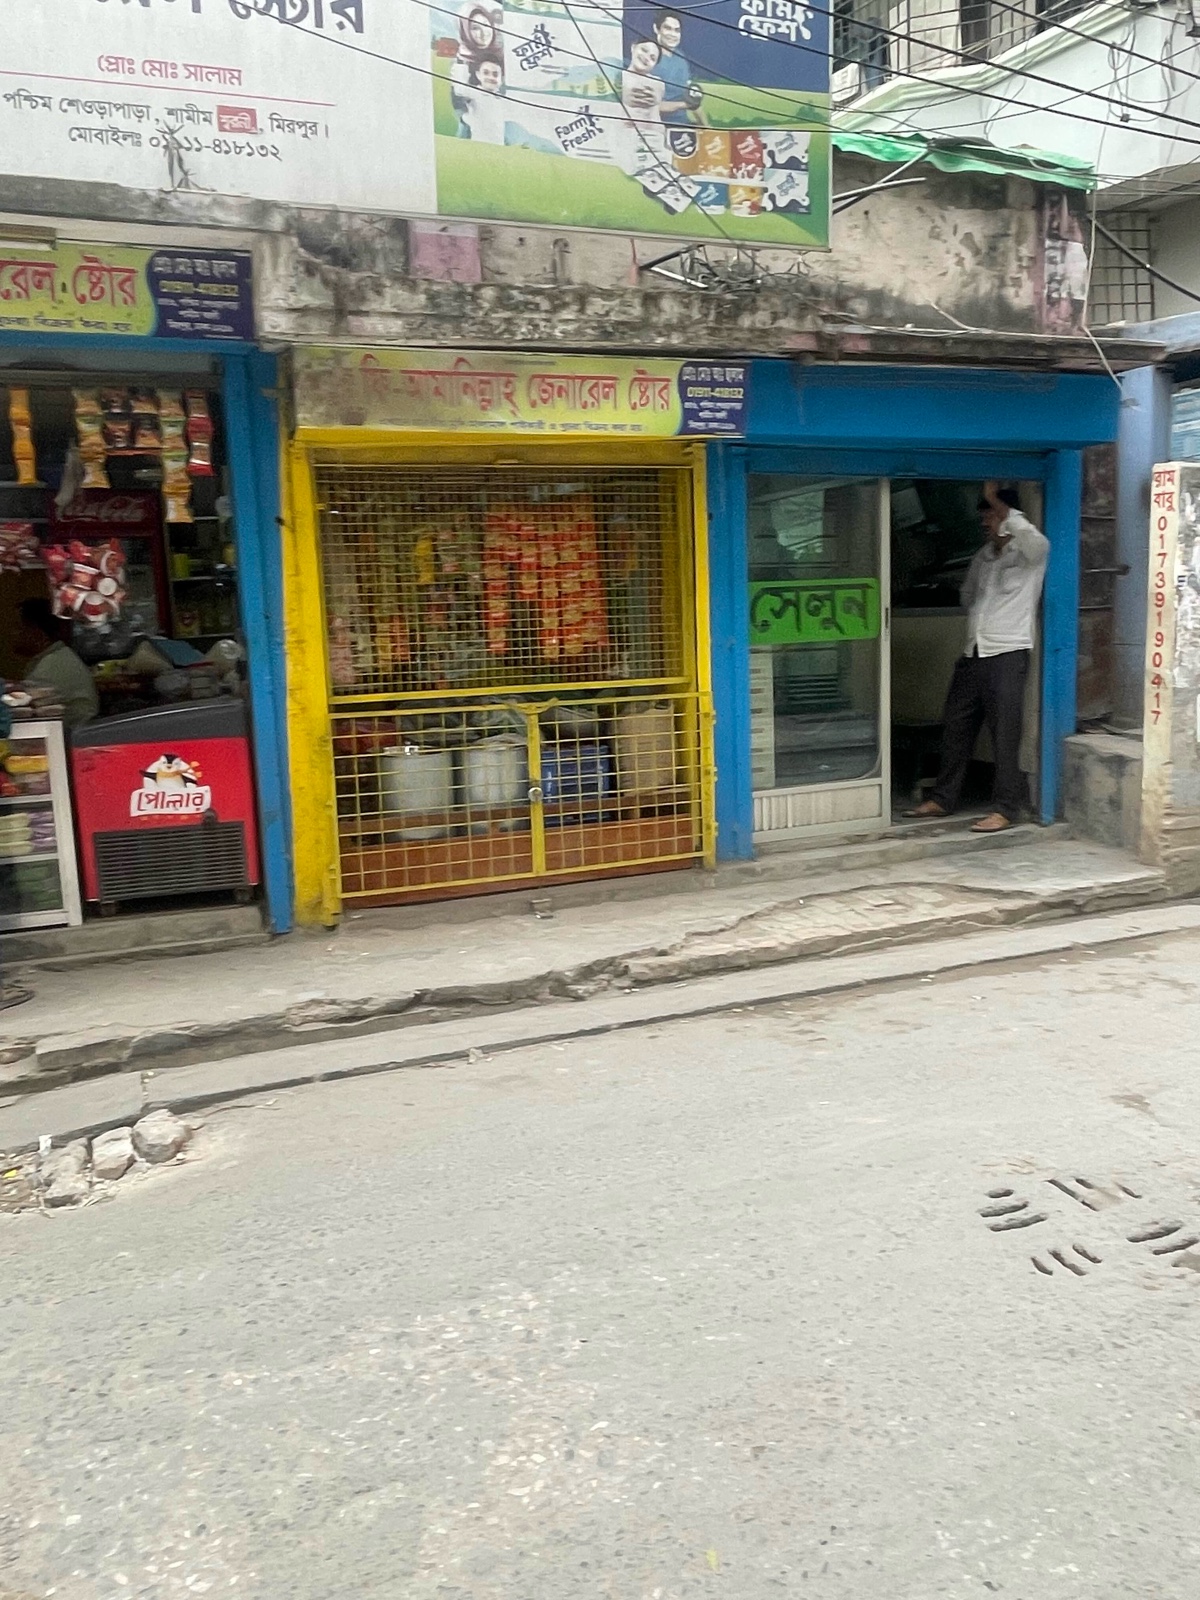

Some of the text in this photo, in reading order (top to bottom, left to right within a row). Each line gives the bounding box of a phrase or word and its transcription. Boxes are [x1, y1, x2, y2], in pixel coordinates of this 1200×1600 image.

[98, 54, 242, 86] প্রোঃ মোঃ সালাম
[3, 88, 53, 111] পশ্চিম
[165, 103, 213, 125] শামীম
[554, 117, 588, 139] Farm
[561, 127, 597, 152] Fresh
[149, 134, 283, 162] ০১১১-৪১৮১৩২
[528, 373, 620, 411] জেনারেল
[1153, 491, 1176, 512] বাবু
[137, 791, 204, 812] পোলার
